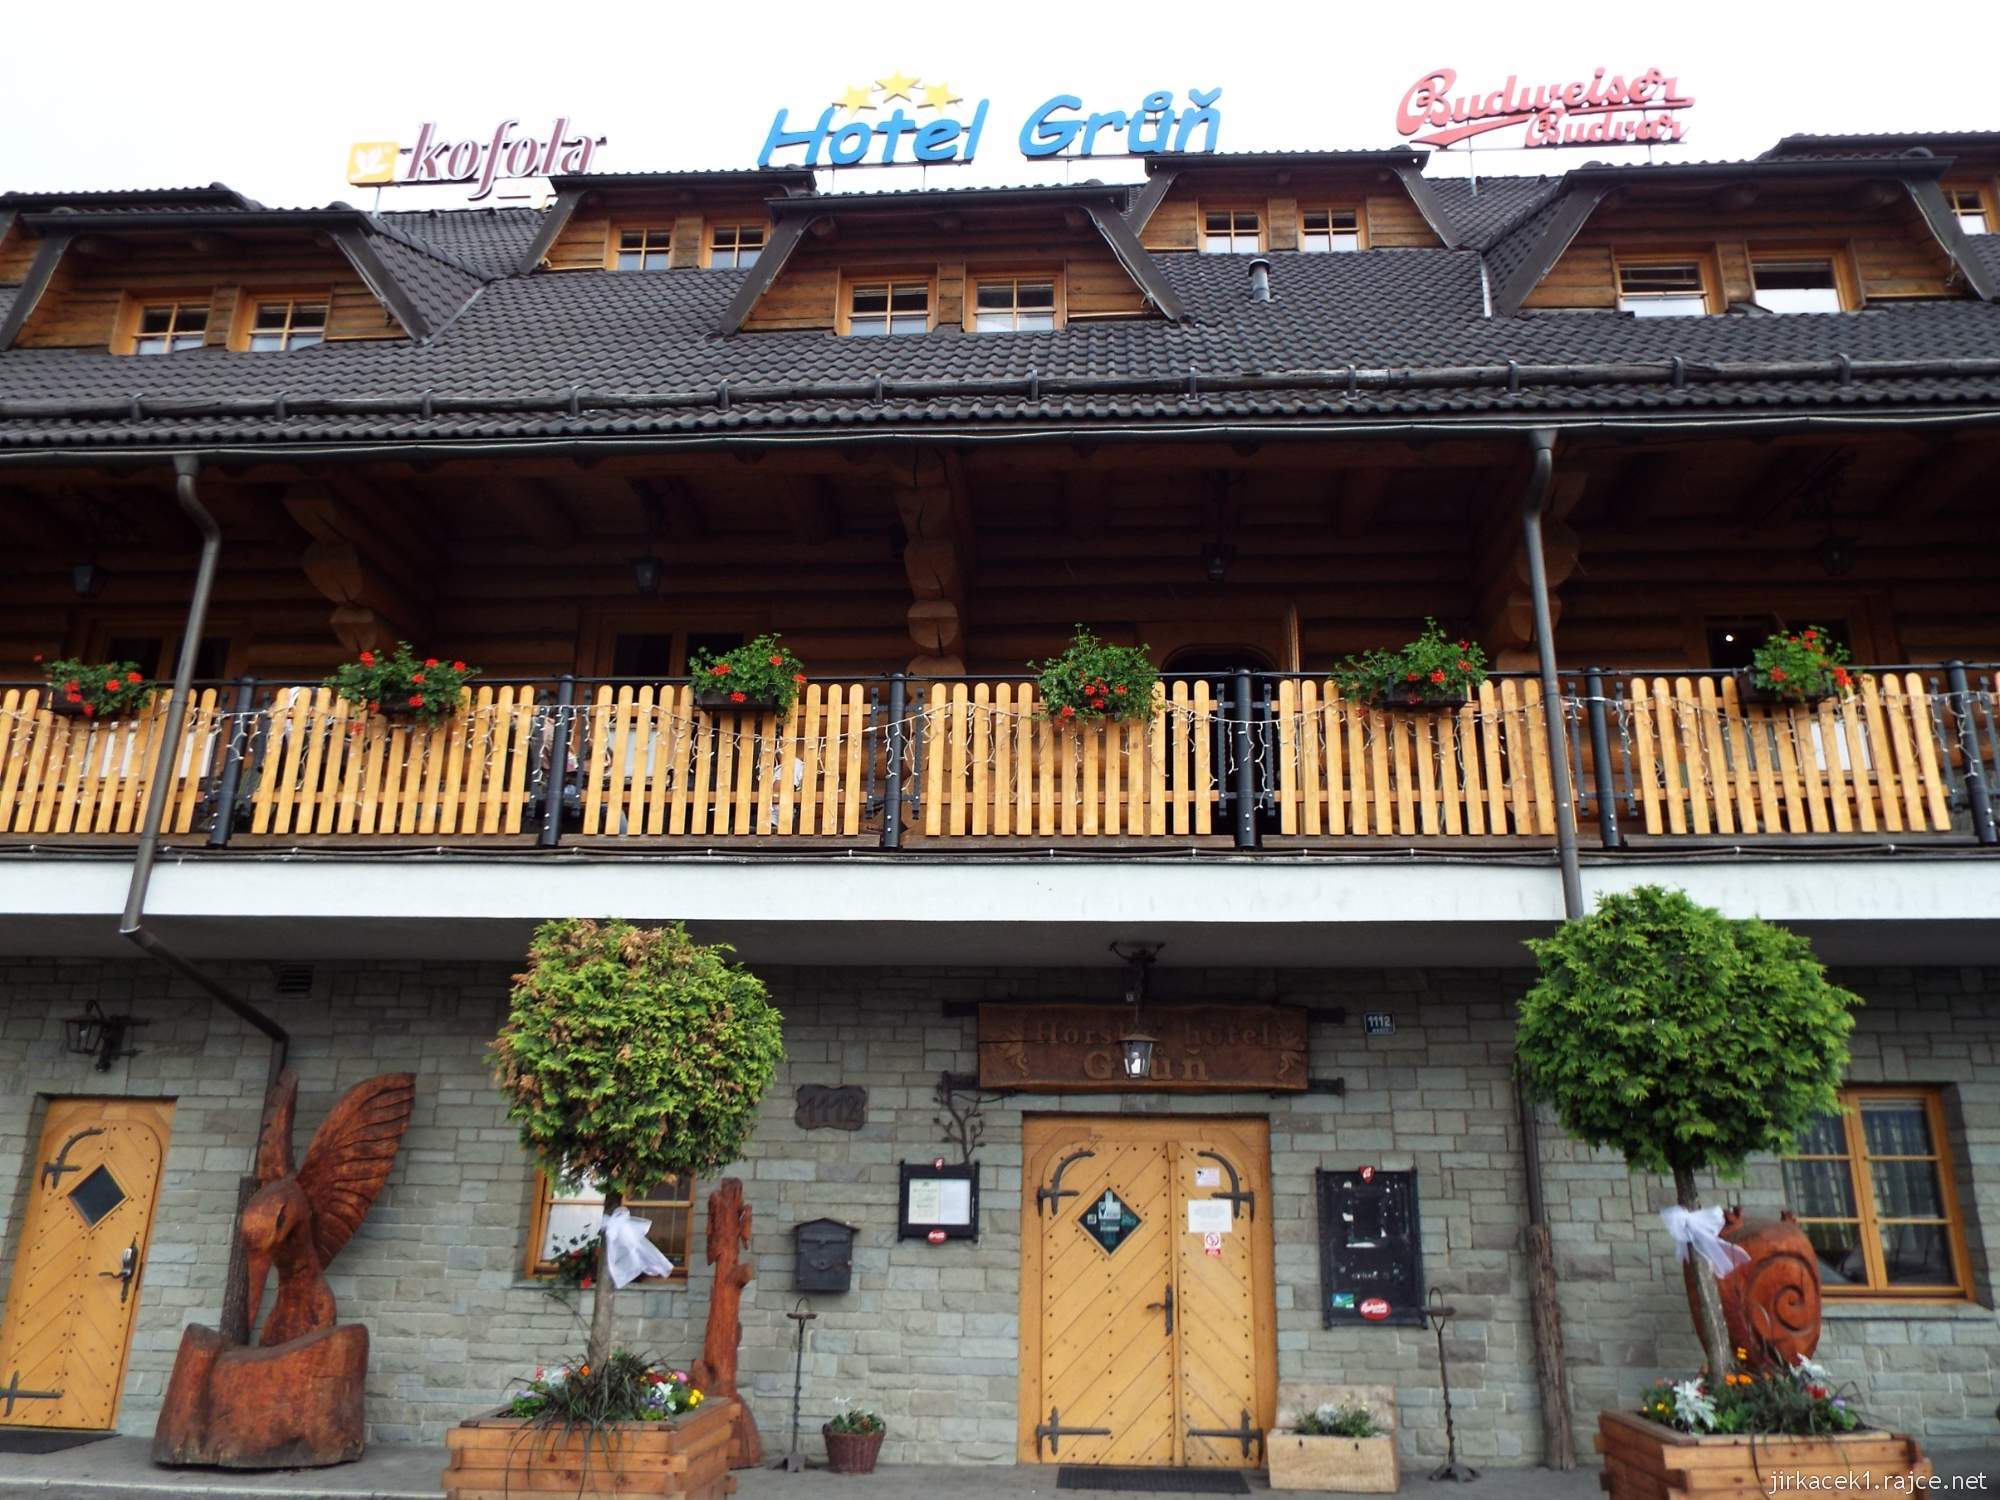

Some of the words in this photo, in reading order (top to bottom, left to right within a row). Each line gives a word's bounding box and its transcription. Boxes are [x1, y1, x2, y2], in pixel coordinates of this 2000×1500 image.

[1396, 67, 1696, 136] Budweiser
[758, 98, 989, 167] Hotel
[1019, 87, 1222, 158] Grůň
[1525, 107, 1690, 148] Budvar
[403, 116, 598, 200] kofola
[1037, 1022, 1158, 1046] Horsk
[1367, 1015, 1391, 1027] 1112
[1083, 1047, 1210, 1082] Gůň
